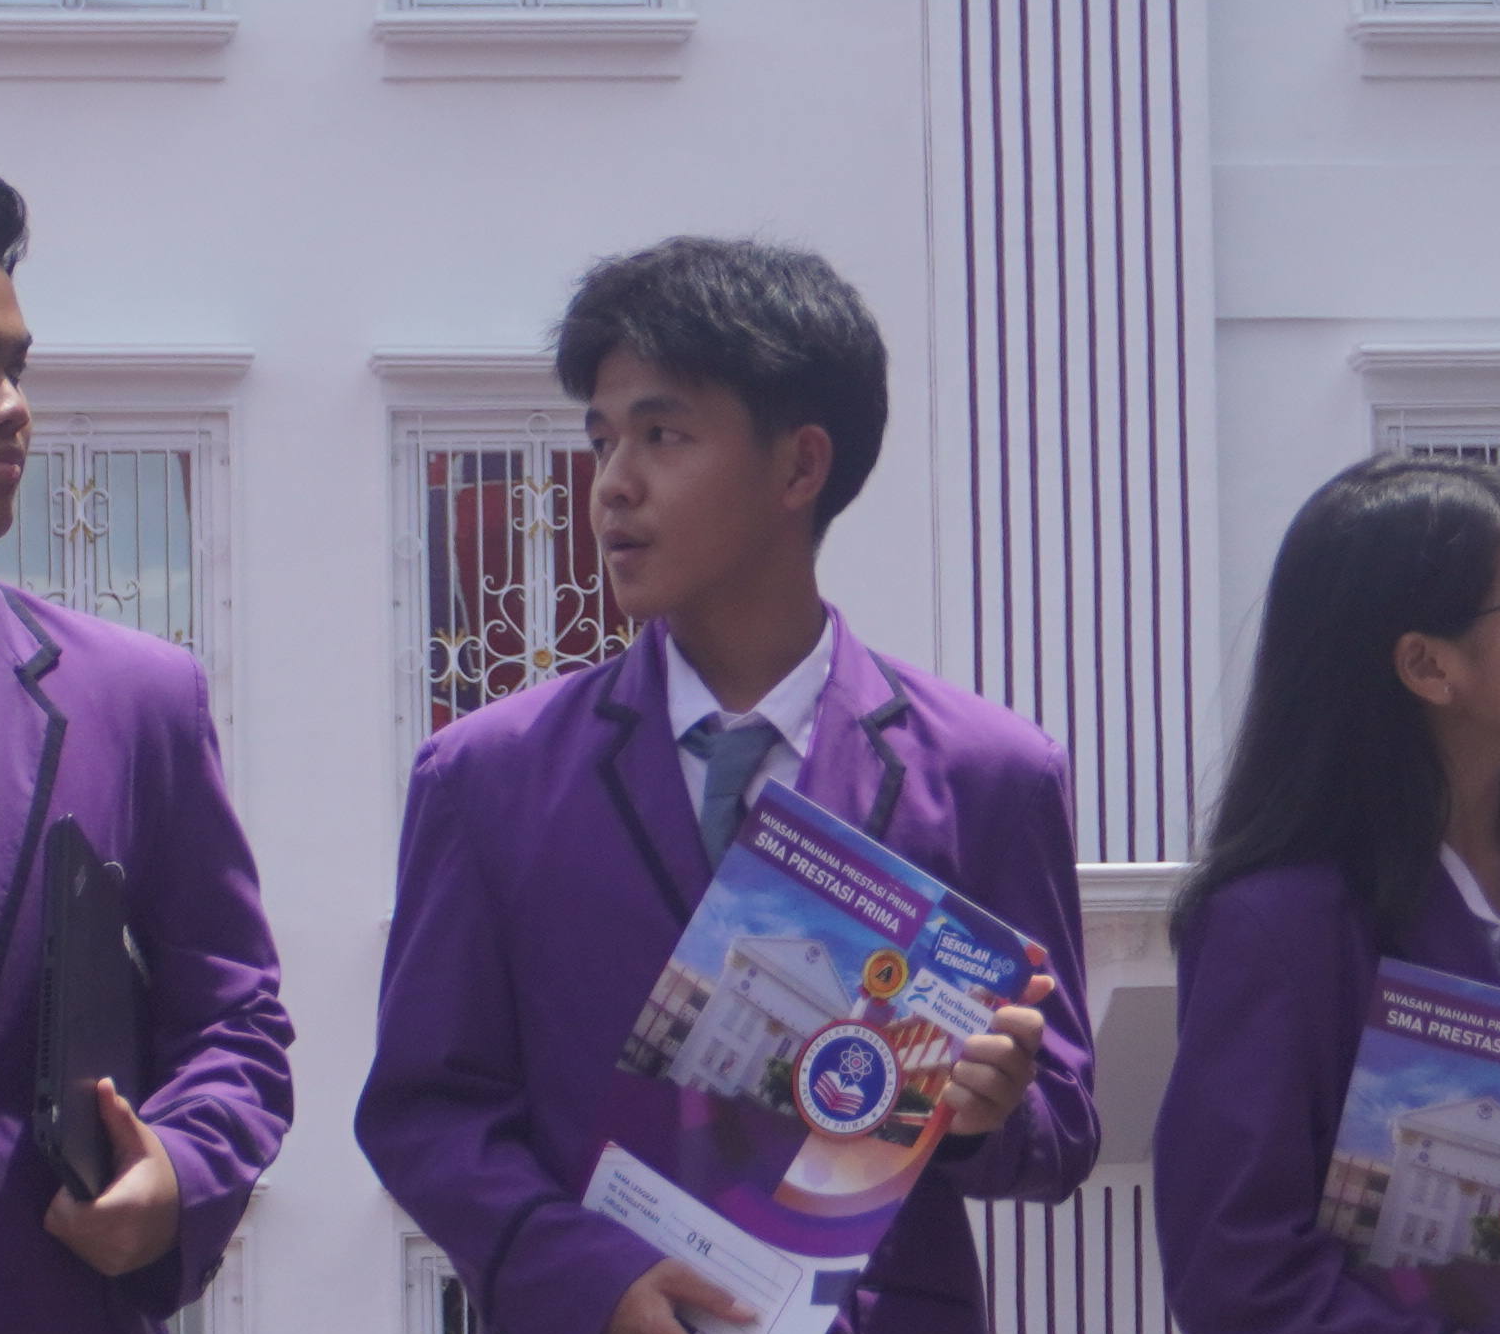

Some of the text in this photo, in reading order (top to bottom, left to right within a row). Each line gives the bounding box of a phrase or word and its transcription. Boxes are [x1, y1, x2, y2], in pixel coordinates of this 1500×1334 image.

[754, 832, 901, 935] SMA PRESTASI PRIMA
[758, 811, 919, 920] YAYASAN WAHANA PRESTASI PRIMA
[934, 950, 1001, 984] PENGGERAK
[939, 935, 991, 964] SEKOLAH
[932, 1000, 975, 1035] Merdeka
[937, 989, 988, 1028] Kurikulum
[1383, 990, 1432, 1013] YAYASAN
[1434, 1003, 1484, 1028] WAHANA
[1386, 1009, 1423, 1033] SMA
